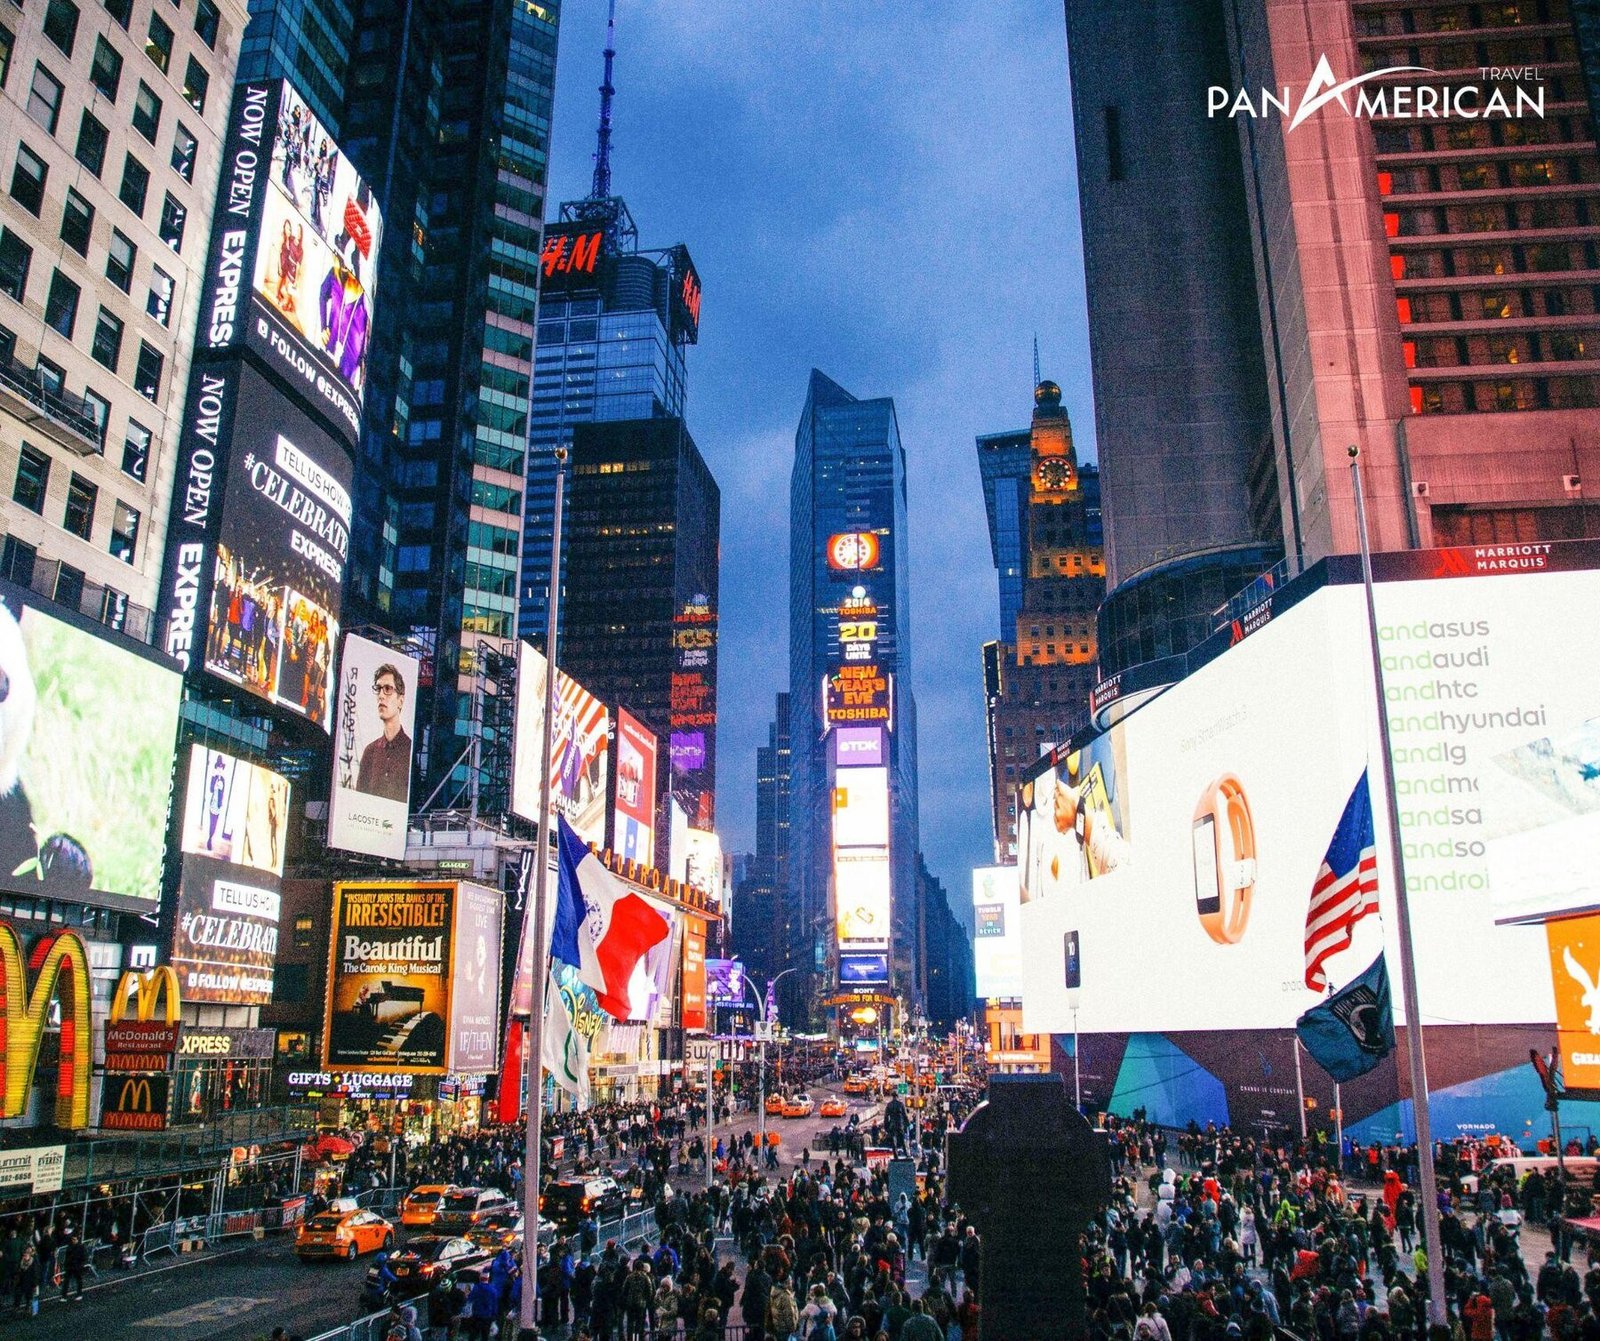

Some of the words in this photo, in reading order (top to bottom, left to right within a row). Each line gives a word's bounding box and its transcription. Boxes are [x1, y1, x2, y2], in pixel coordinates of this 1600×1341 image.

[239, 86, 268, 147] NOW
[228, 151, 258, 218] OPEN
[209, 231, 247, 347] EXPRES
[270, 331, 316, 383] FOLLOW
[195, 373, 225, 446] NOW
[283, 447, 306, 477] TELL
[308, 468, 322, 488] US
[183, 450, 215, 529] OPEN
[291, 529, 341, 583] EXPRESS
[1475, 545, 1551, 558] MARRIOTT
[1477, 557, 1545, 570] MARQUIS
[838, 607, 877, 615] TOSHIBA
[1243, 597, 1273, 623] MARRIOTT
[839, 624, 877, 640] 20
[1244, 612, 1271, 635] MARQUIS
[1379, 619, 1490, 641] andasus
[845, 651, 872, 660] UNTIL
[846, 643, 871, 651] DAYS
[1382, 645, 1490, 671] andaudi
[839, 666, 878, 679] NEW
[832, 678, 886, 692] YEAR'S
[1385, 680, 1479, 701] andhtc
[843, 692, 874, 704] EVE
[828, 708, 889, 720] TOSHIBA
[1389, 704, 1547, 734] andhyundai
[850, 740, 878, 751] TDK
[1394, 742, 1466, 765] andlg
[348, 813, 379, 827] LACOSTE
[1401, 806, 1482, 828] andsa
[1404, 838, 1486, 860] andso
[628, 858, 707, 911] BROADWAY
[220, 888, 243, 906] TELL
[245, 891, 258, 908] US
[343, 935, 443, 961] Beautiful
[343, 962, 359, 973] The
[360, 962, 387, 973] Carole
[388, 963, 408, 976] King
[409, 962, 442, 974] Musical
[201, 973, 239, 990] FOLLOW
[107, 1030, 174, 1041] McDonald's
[180, 1035, 231, 1054] XPRESS
[288, 1072, 332, 1085] GIFTS
[342, 1074, 413, 1088] LUGGAGE
